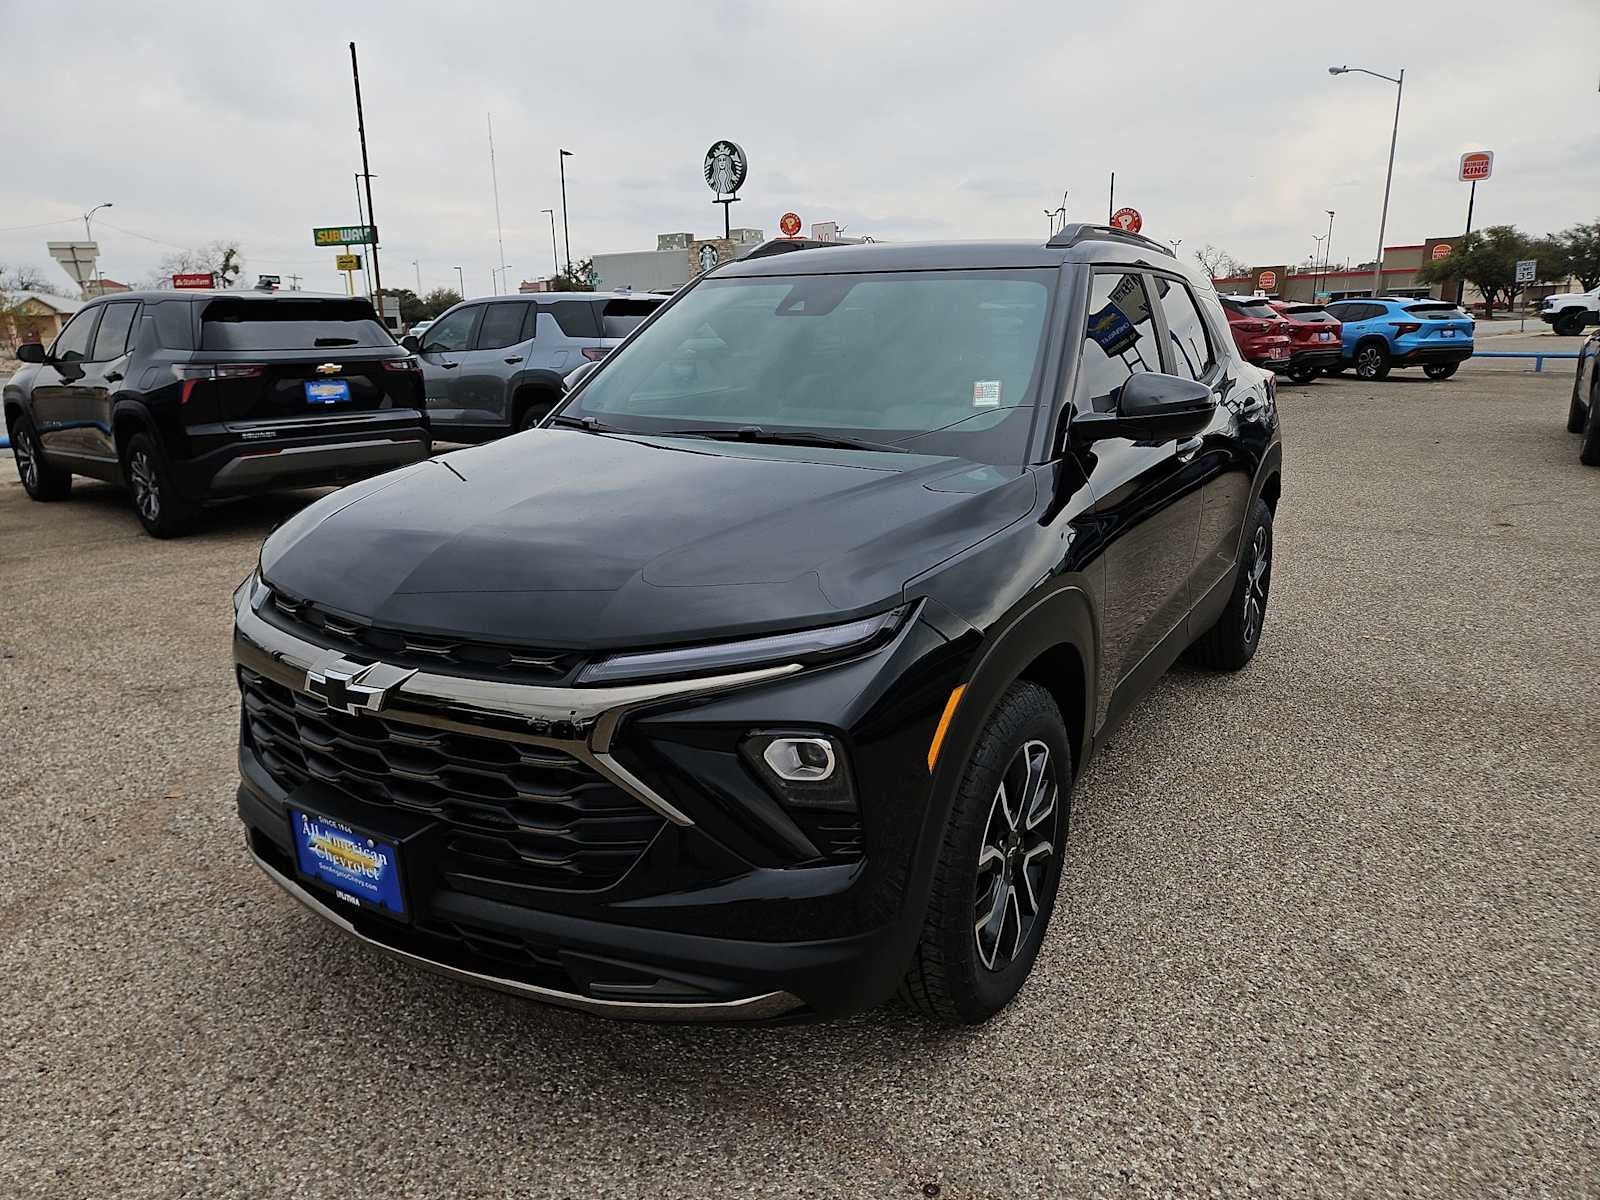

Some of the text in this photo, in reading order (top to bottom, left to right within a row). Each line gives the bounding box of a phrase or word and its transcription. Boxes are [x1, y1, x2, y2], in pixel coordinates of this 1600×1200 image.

[1463, 167, 1488, 175] KING
[317, 228, 371, 242] SUBWAY
[1518, 272, 1534, 280] 35
[318, 816, 337, 829] SINCE
[302, 822, 388, 866] All American
[314, 844, 380, 881] Chevrolet
